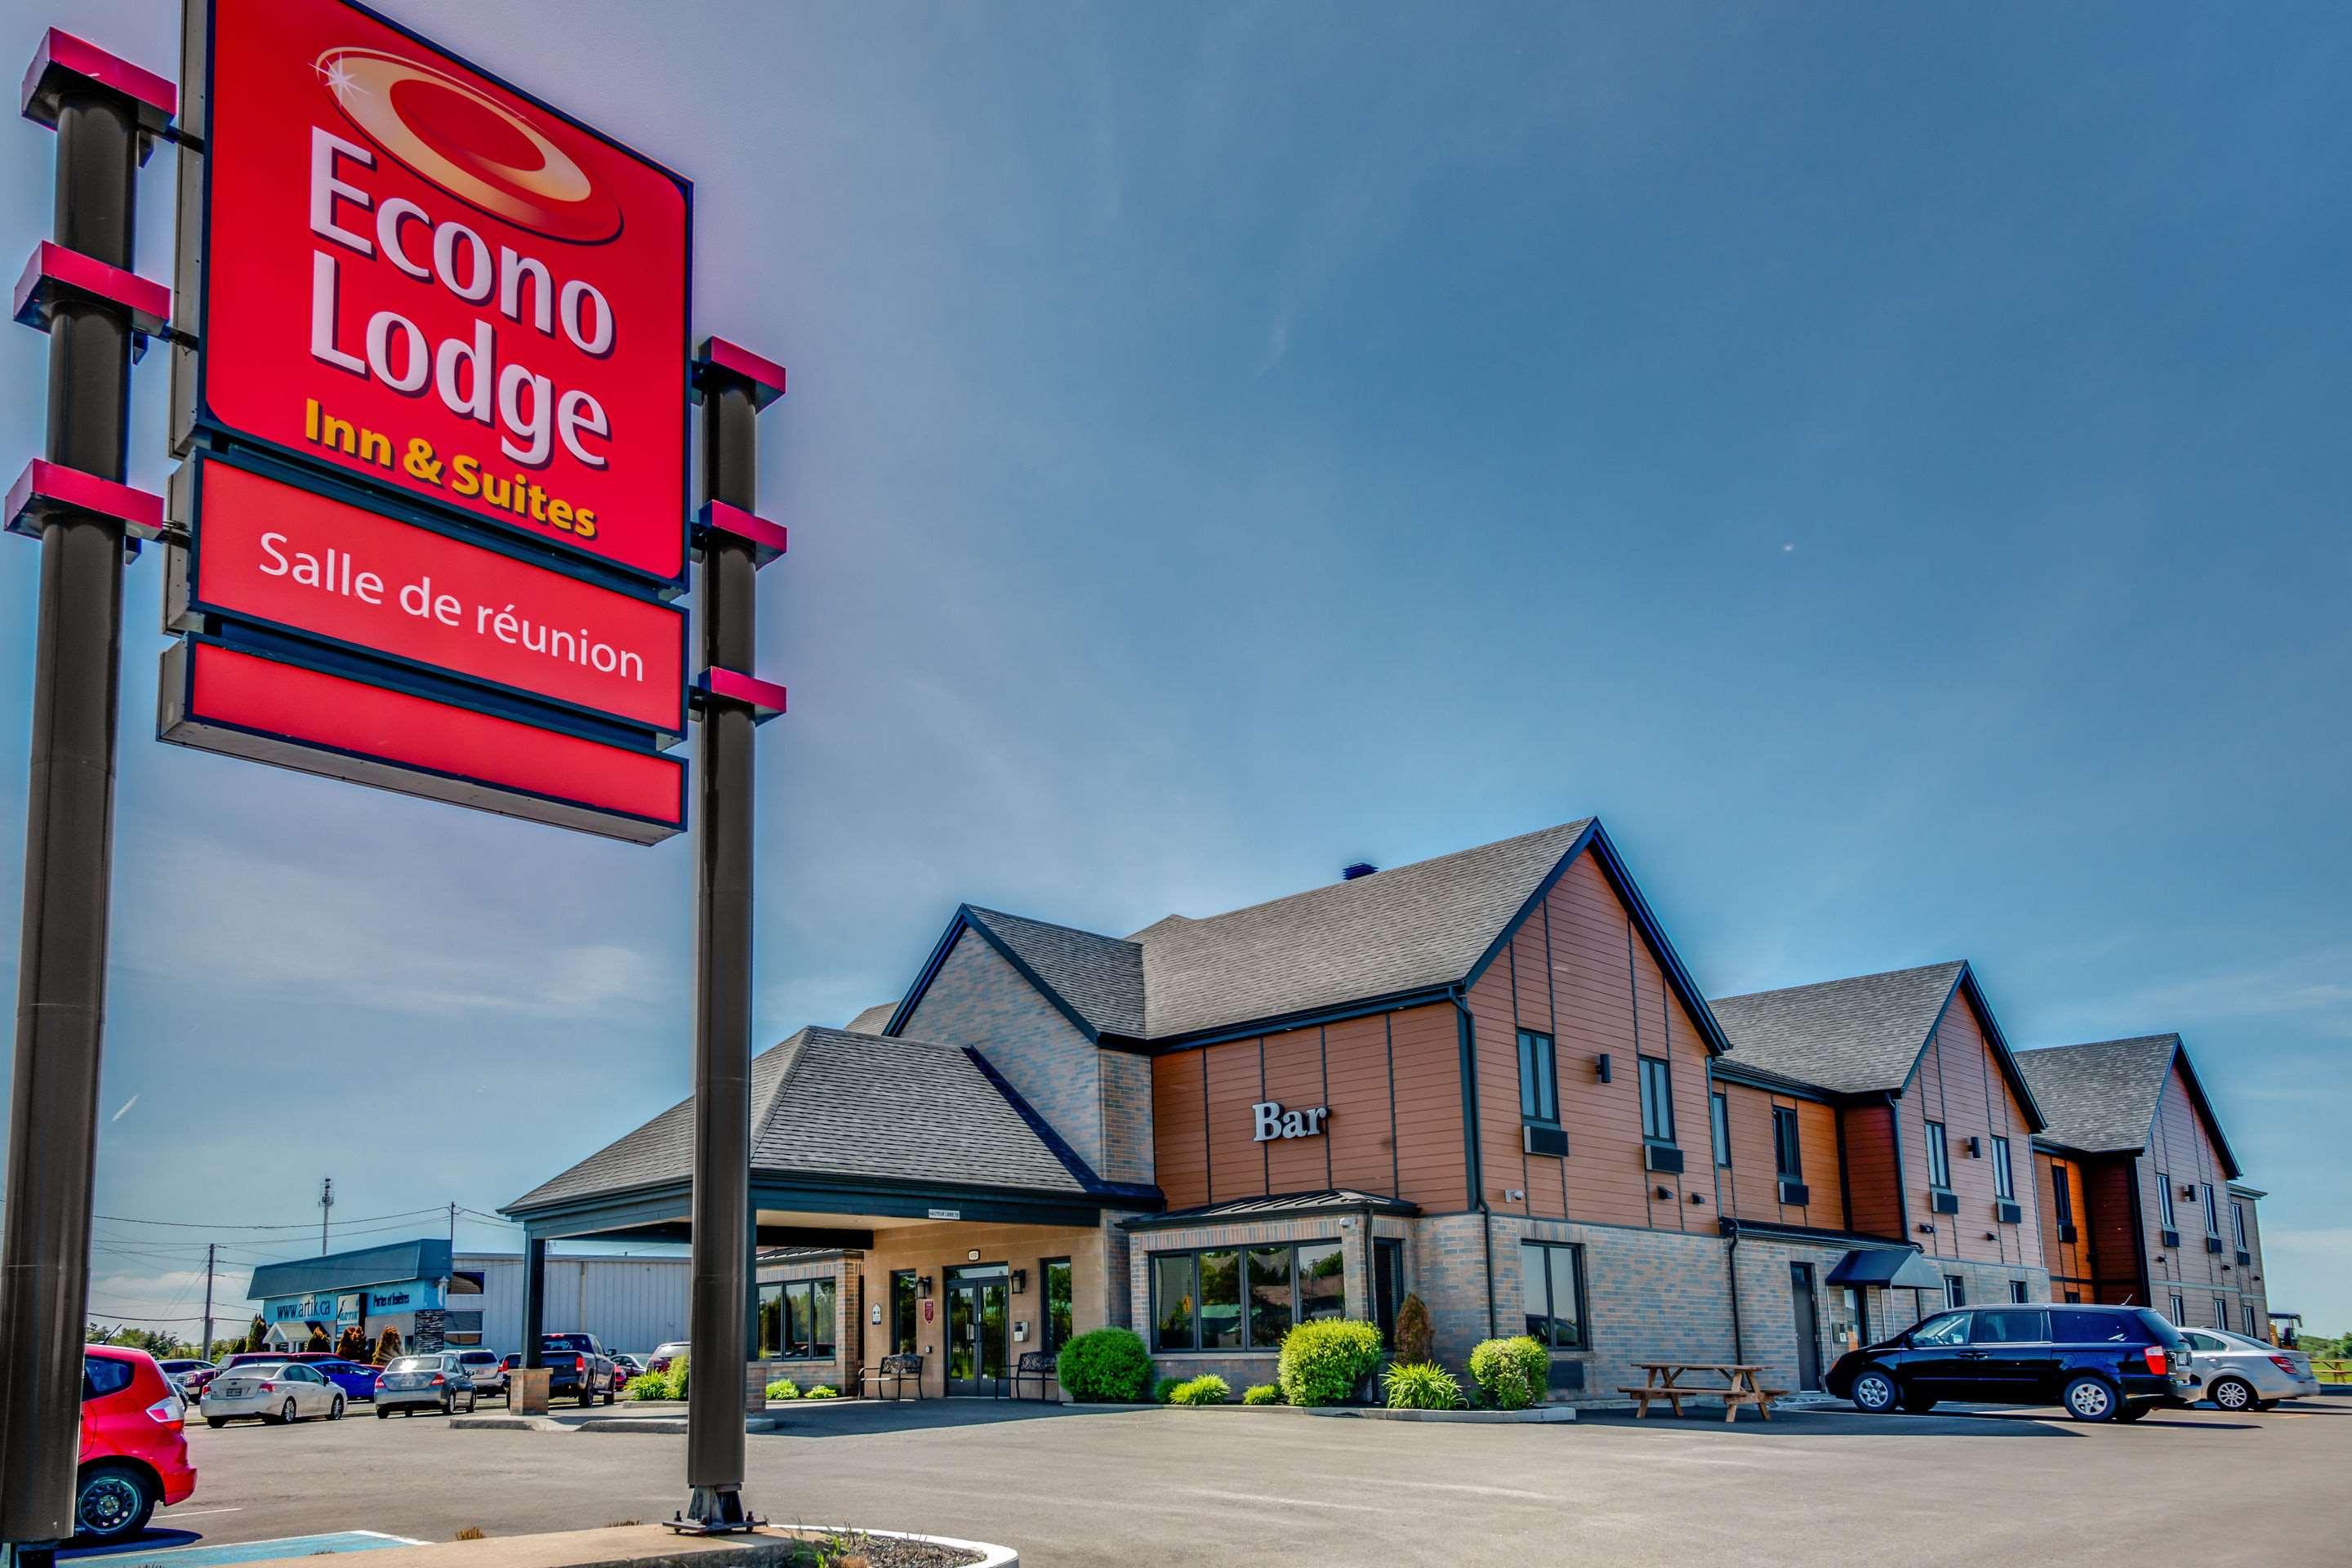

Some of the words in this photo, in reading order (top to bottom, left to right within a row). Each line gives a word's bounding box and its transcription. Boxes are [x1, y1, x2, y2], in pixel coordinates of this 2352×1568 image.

[310, 127, 612, 355] Econo
[311, 251, 608, 466] Lodge
[306, 399, 392, 466] Inn
[403, 439, 443, 485] &
[452, 456, 596, 537] Suites
[259, 532, 384, 604] Salle
[399, 577, 462, 627] de
[477, 604, 644, 682] réunion
[1252, 1102, 1327, 1142] Bar
[277, 1294, 331, 1320] www.artik.ca
[339, 1312, 358, 1321] ARTIK
